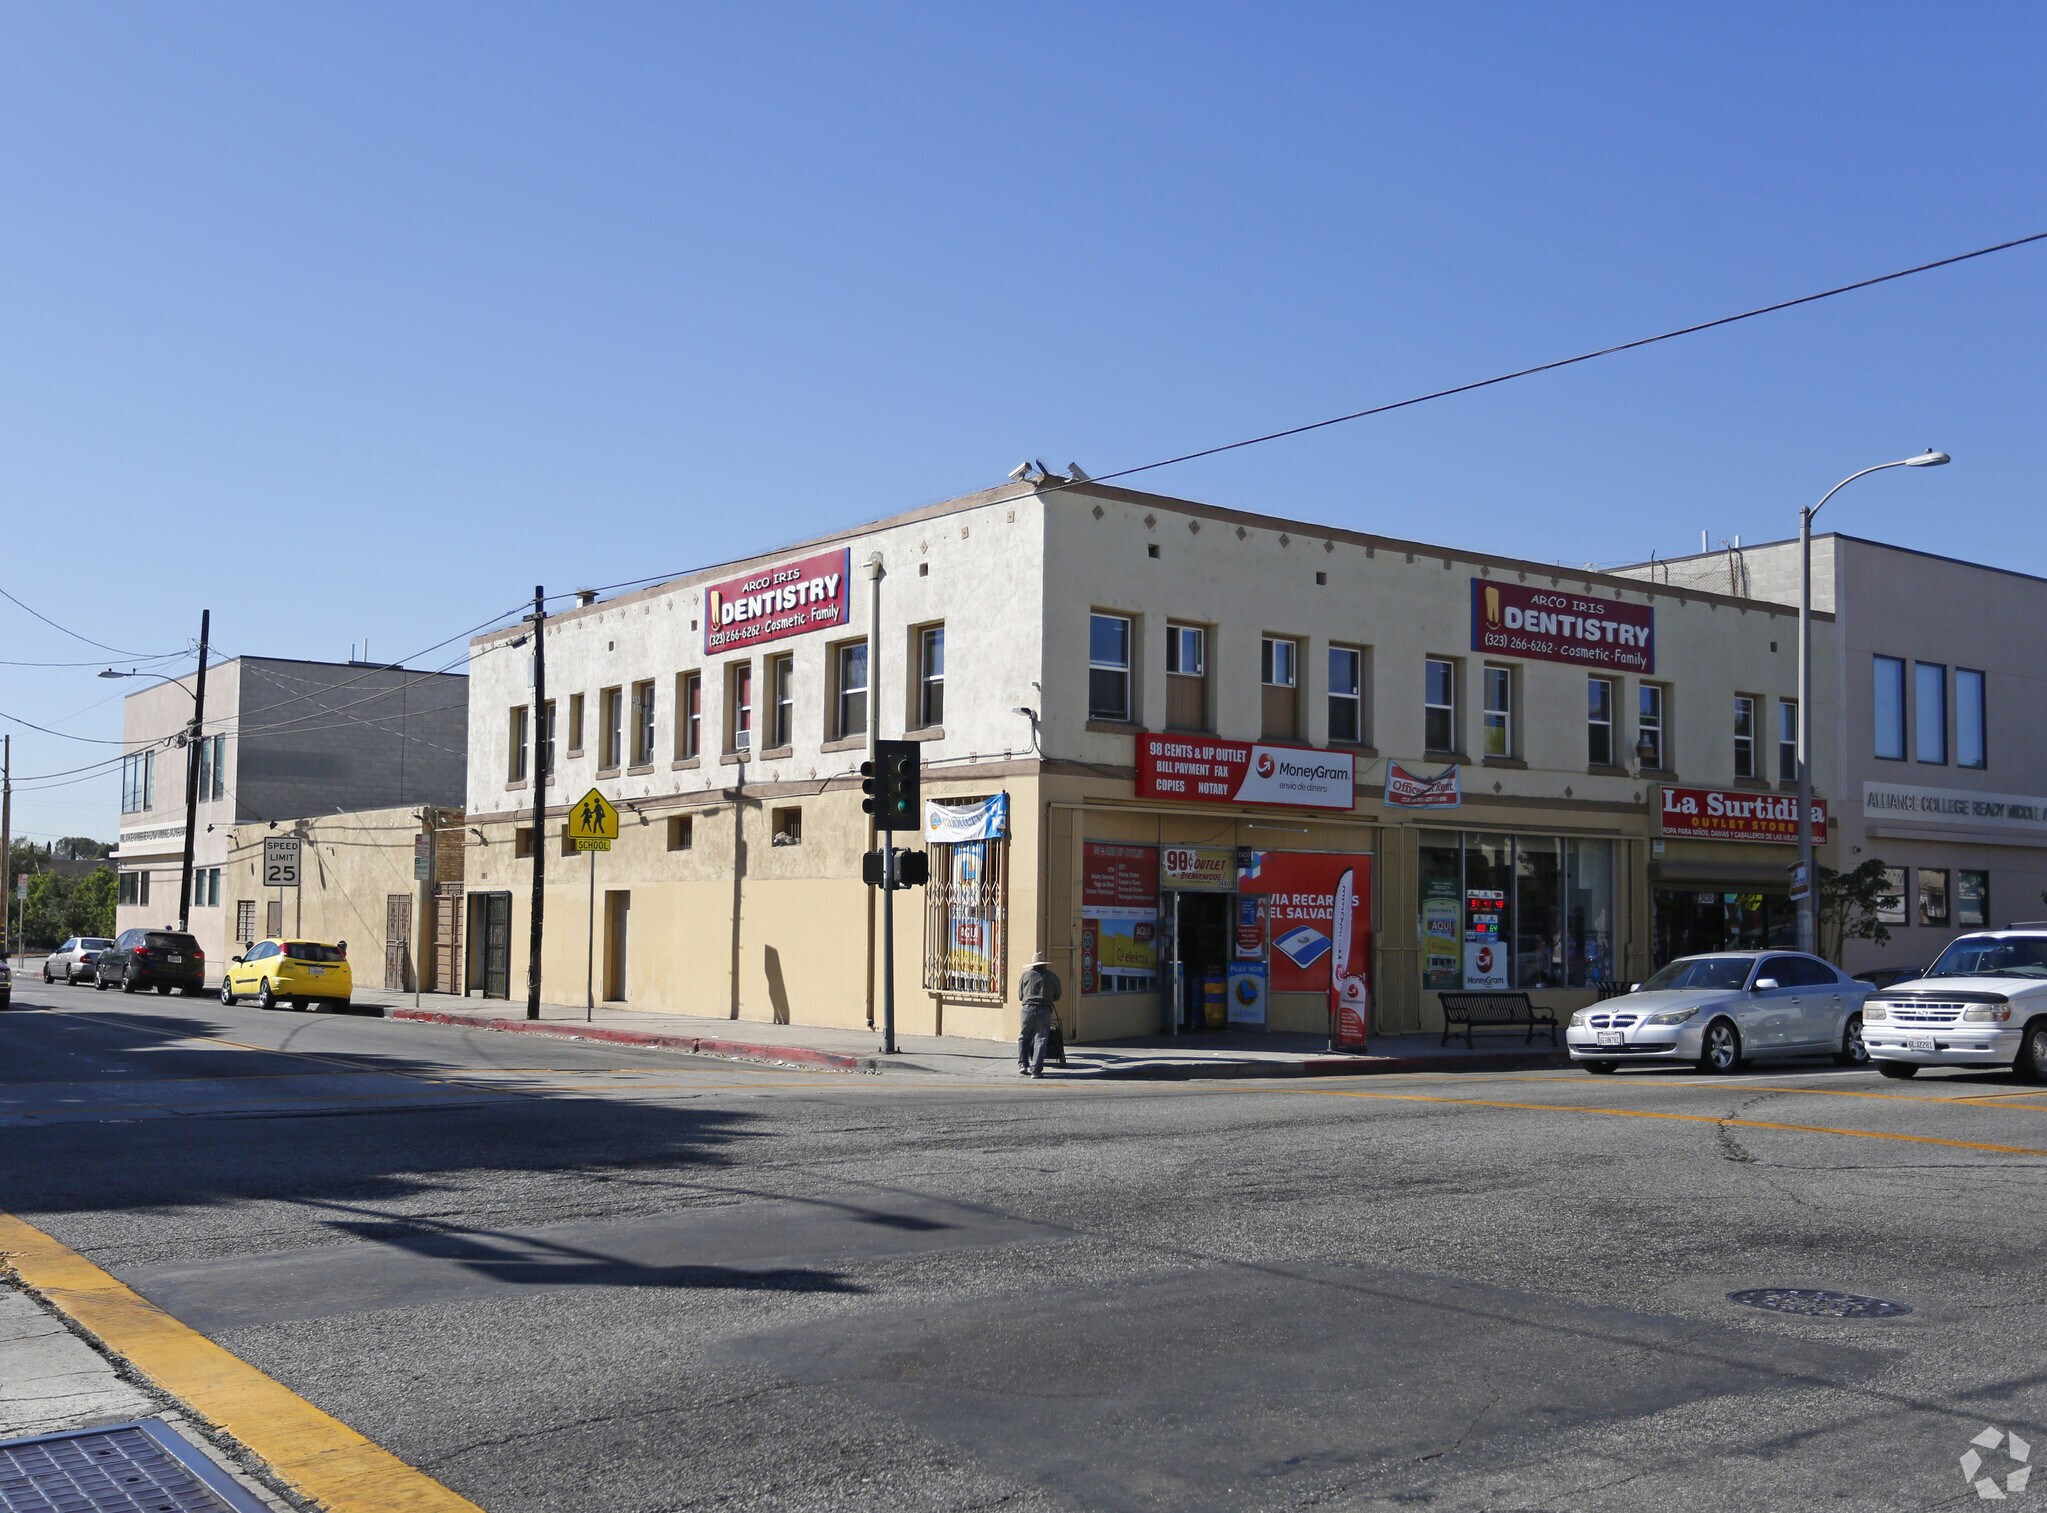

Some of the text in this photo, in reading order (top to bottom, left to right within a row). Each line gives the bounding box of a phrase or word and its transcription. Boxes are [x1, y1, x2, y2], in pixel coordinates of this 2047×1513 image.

[742, 569, 801, 593] ARCO IRIS
[722, 573, 839, 625] DENTISTRY
[1530, 594, 1605, 615] ARCO IRIS
[709, 603, 839, 647] (323) 266-6262 Cosmetic Family
[1504, 606, 1649, 648] DENTISTRY
[1484, 632, 1647, 670] (323) 266-6262 Cosmetic Family
[1149, 741, 1247, 763] 98 CENTS & UP OUTLET
[1156, 761, 1228, 778] BILL PAYMENT FAX
[1156, 778, 1228, 795] COPIES NOTARY
[1297, 782, 1306, 791] de
[1306, 783, 1328, 793] dinero
[1662, 789, 1825, 823] La Surtidia
[1867, 791, 1920, 811] ALLIANCE
[1921, 796, 1970, 815] COLLEGE
[1972, 801, 2006, 818] READY
[1691, 817, 1795, 833] OUTLET STORE
[267, 842, 298, 850] SPEED
[578, 840, 608, 849] SCHOOL
[1194, 858, 1227, 870] OUTLET
[268, 865, 295, 881] 25
[1292, 894, 1360, 907] RECARS
[1256, 907, 1333, 919] A EL SALVAD
[1467, 976, 1504, 986] MoneyGram
